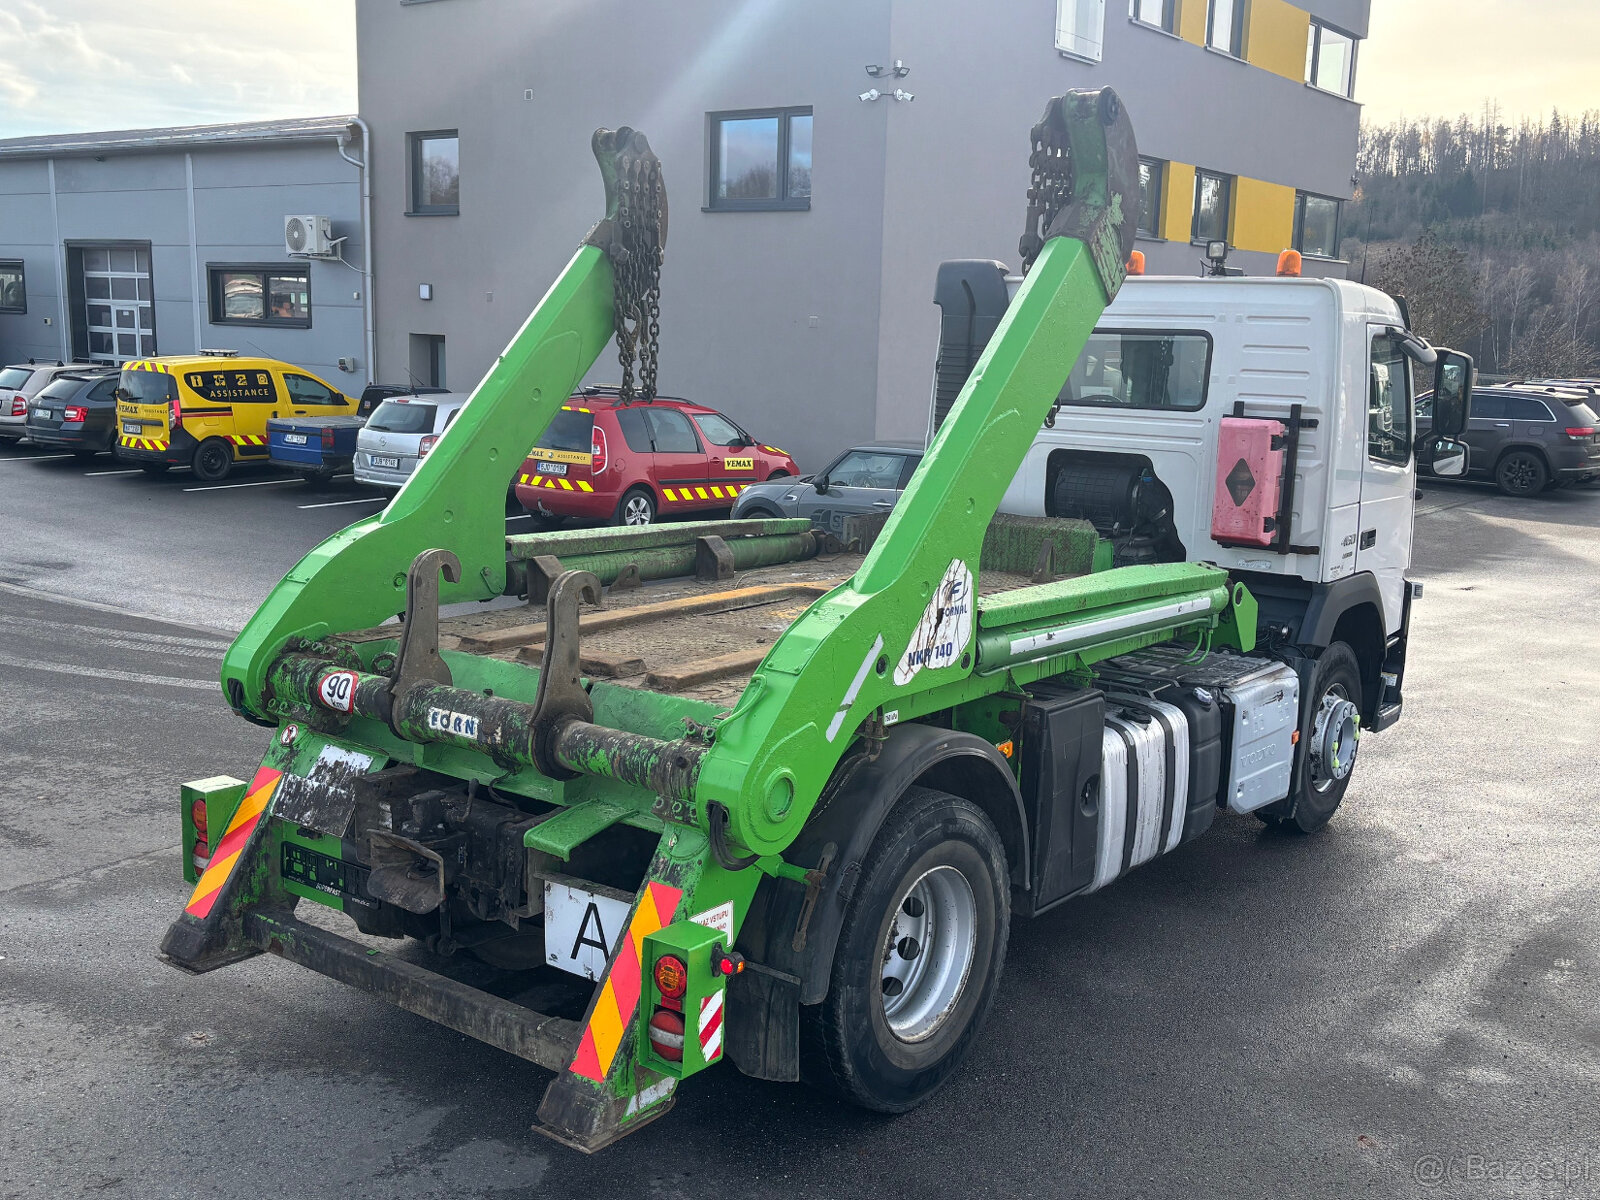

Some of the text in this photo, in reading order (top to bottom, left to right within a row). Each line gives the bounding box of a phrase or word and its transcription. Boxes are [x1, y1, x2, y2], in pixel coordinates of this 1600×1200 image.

[210, 388, 269, 398] ASSISTANCE
[726, 460, 752, 468] VEMAX
[327, 675, 351, 700] 90
[570, 902, 610, 962] A
